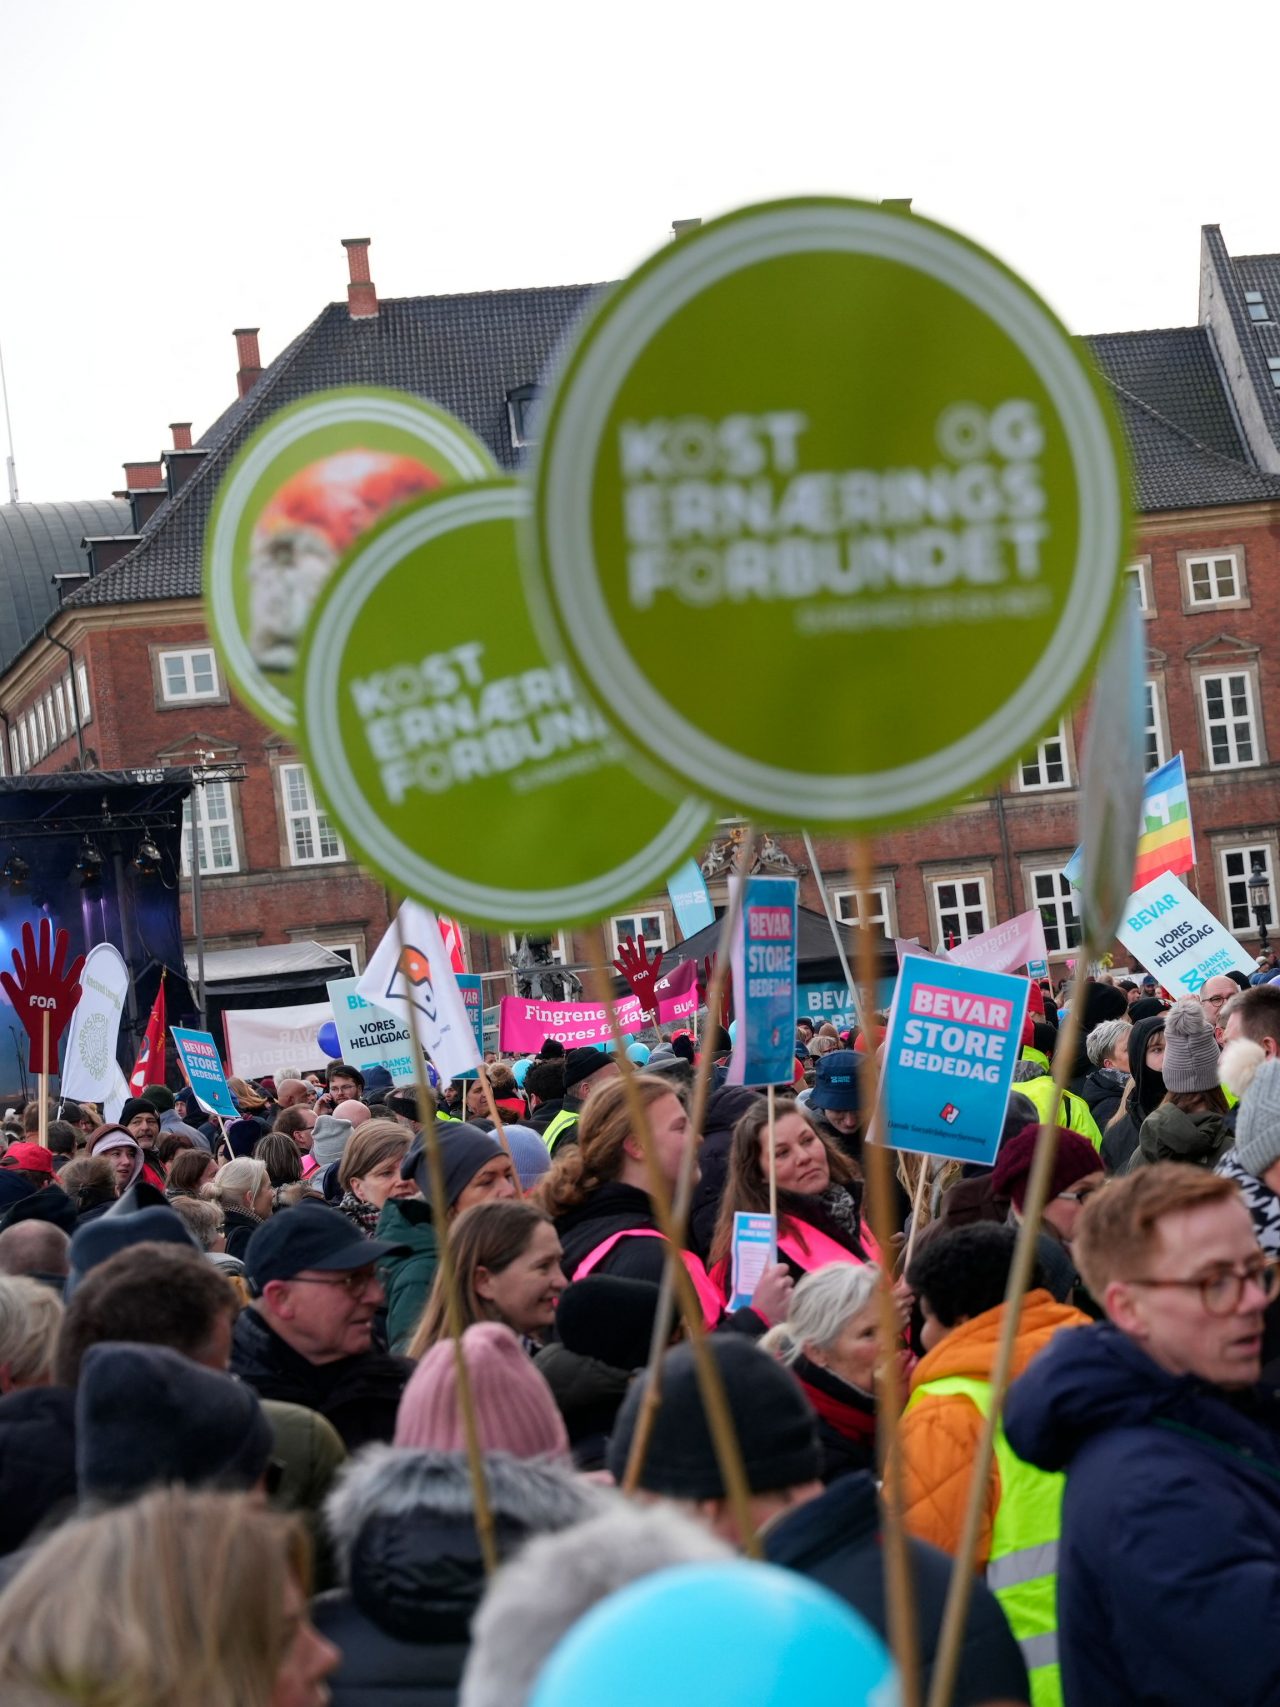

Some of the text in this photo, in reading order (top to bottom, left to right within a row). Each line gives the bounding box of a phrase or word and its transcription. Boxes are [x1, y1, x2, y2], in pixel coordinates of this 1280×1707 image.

[618, 399, 1046, 481] KOST OG
[623, 461, 1049, 544] ERNÆRINGS
[629, 520, 1050, 611] FORBUNDET
[351, 641, 485, 718] KOST
[749, 911, 791, 936] BEVAR
[1127, 893, 1180, 933] BEVAR
[1154, 924, 1214, 968] HELLIGDAG
[1155, 921, 1193, 950] VORES
[749, 946, 791, 974] STORE
[1198, 948, 1229, 972] DANSK
[1205, 958, 1235, 980] METAL
[633, 970, 649, 982] FOA
[749, 978, 791, 998] BEDEDAG
[29, 995, 57, 1009] FOA
[524, 1005, 606, 1026] Fingrene
[654, 978, 670, 992] ra
[913, 989, 1008, 1028] BEVAR
[360, 1019, 396, 1034] VORES
[543, 1027, 595, 1043] vores
[182, 1041, 214, 1056] BEVAR
[350, 1030, 410, 1050] HELLIGDAG
[903, 1019, 1006, 1061] STORE
[186, 1055, 219, 1072] STORE
[381, 1056, 412, 1069] DANSK
[392, 1067, 413, 1077] ETAL
[898, 1050, 1000, 1084] BEDEDAG
[190, 1069, 223, 1082] BEDEDAG
